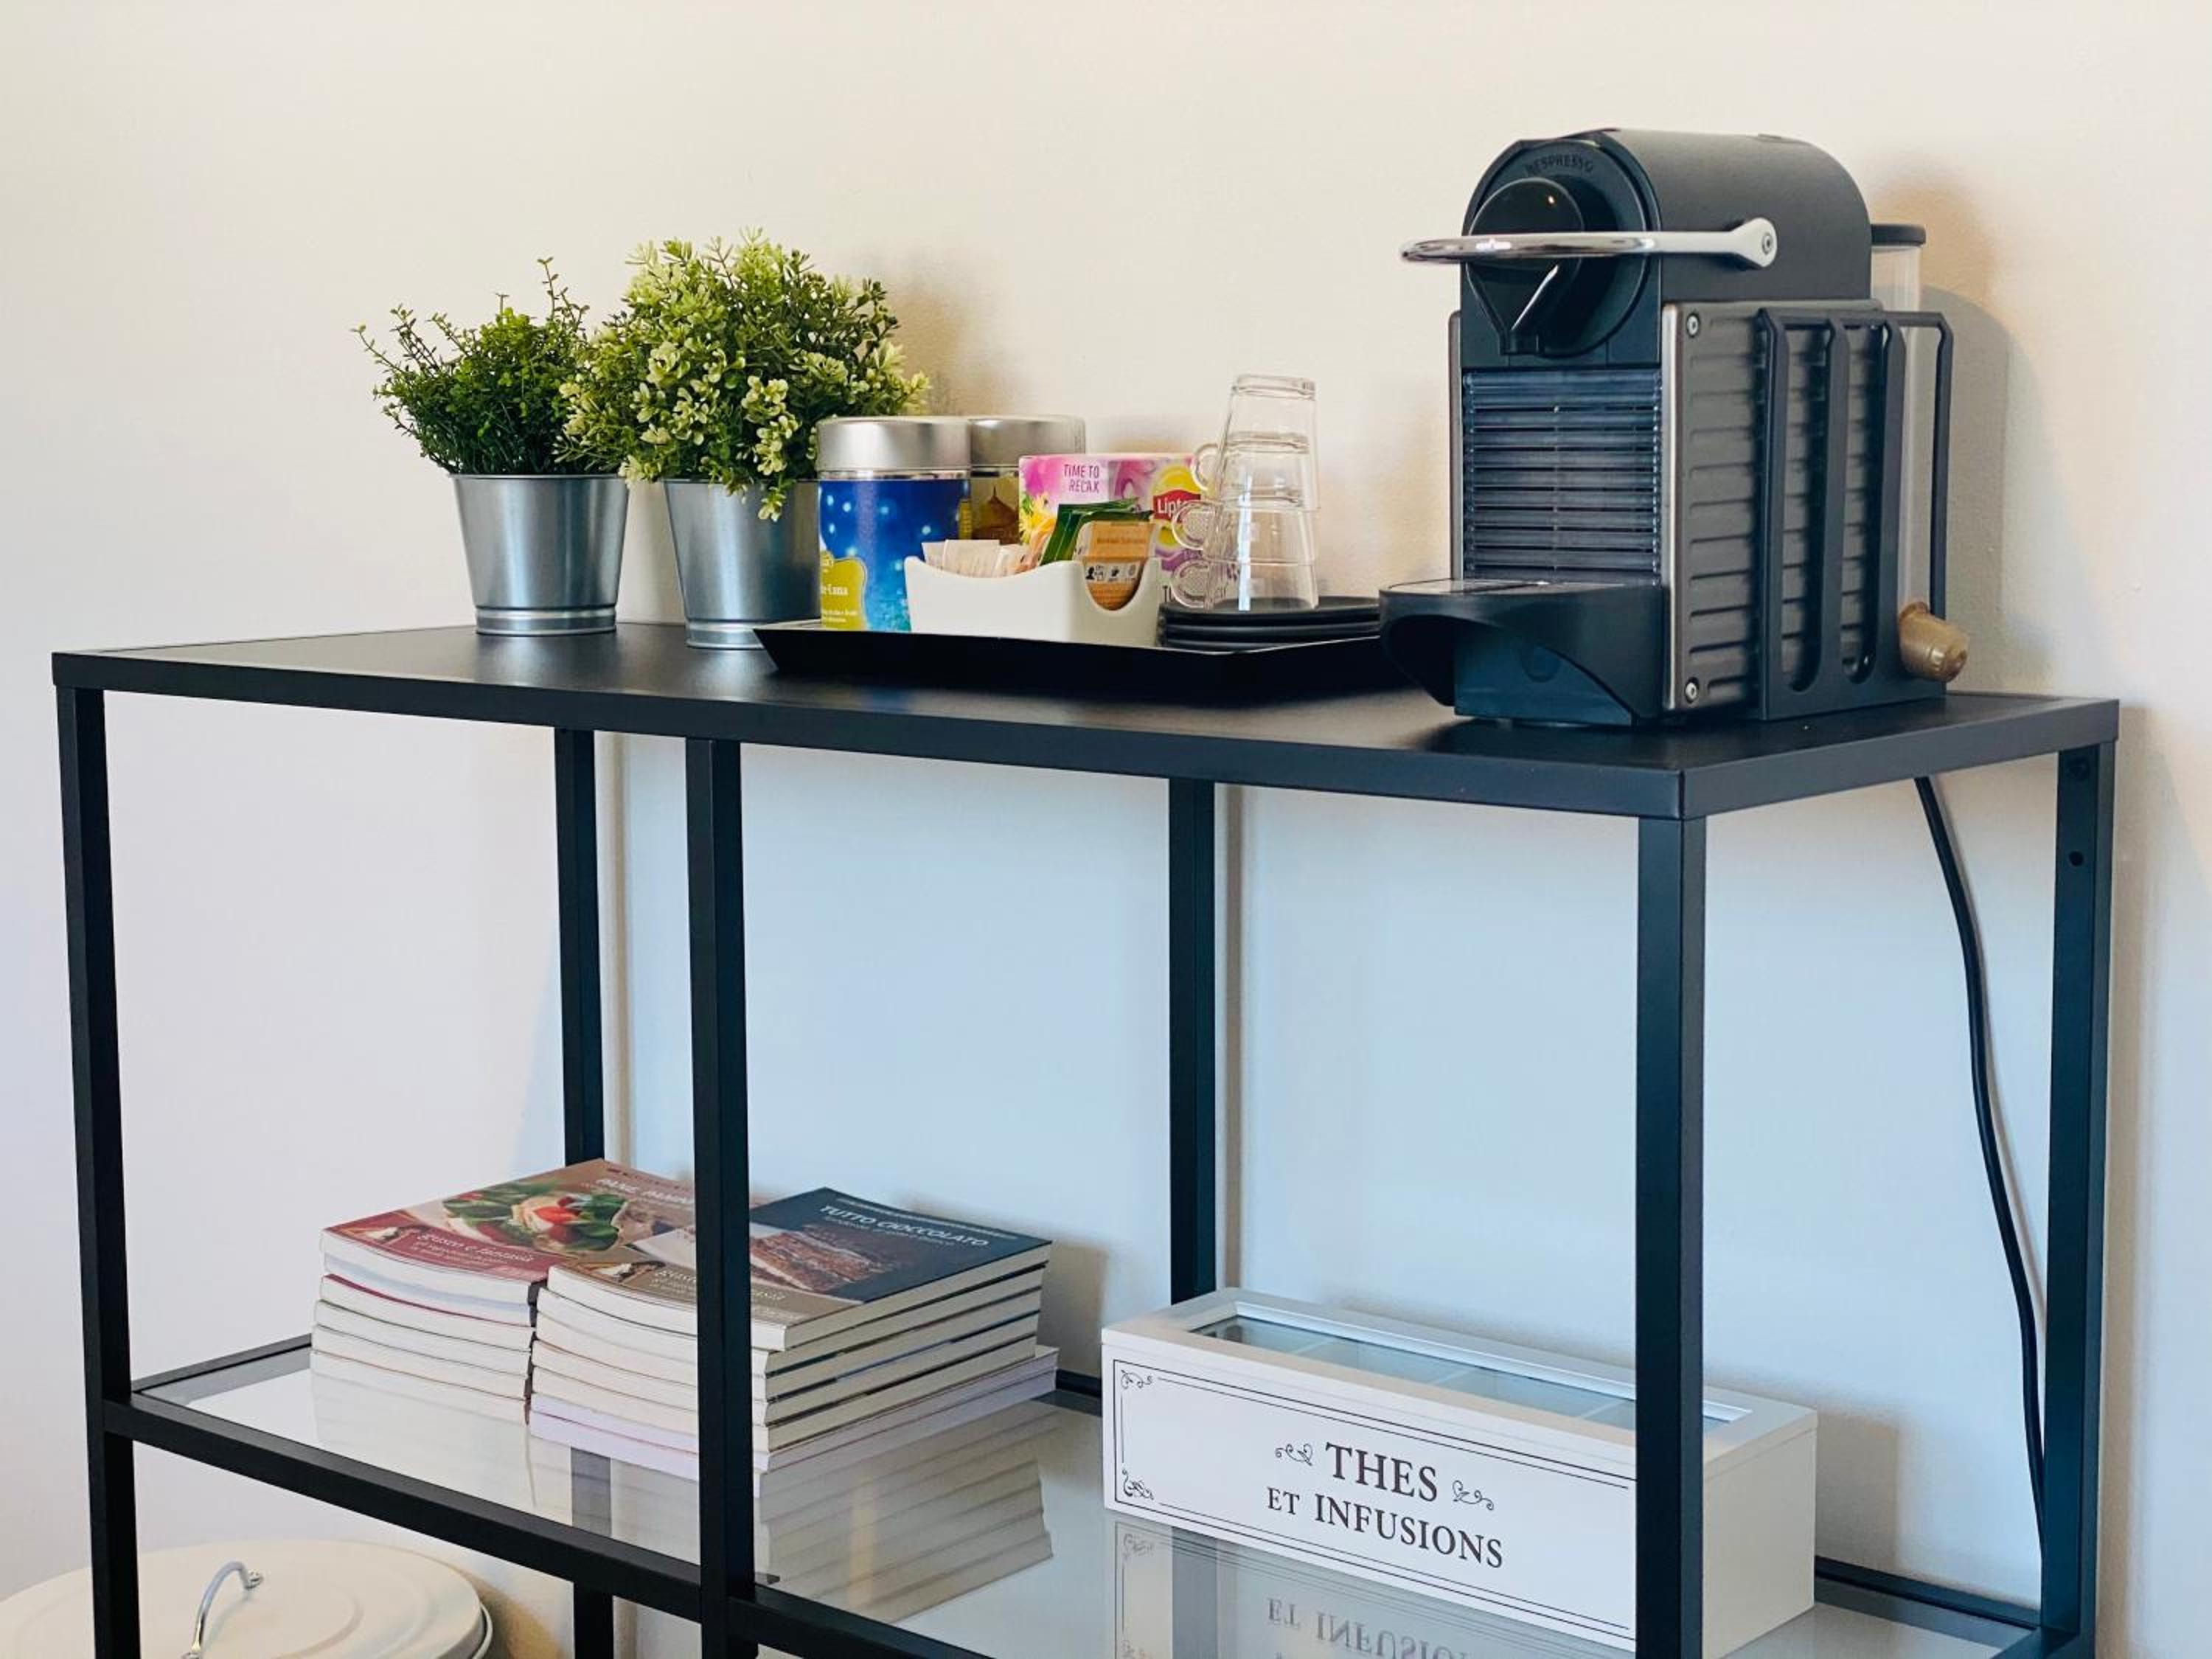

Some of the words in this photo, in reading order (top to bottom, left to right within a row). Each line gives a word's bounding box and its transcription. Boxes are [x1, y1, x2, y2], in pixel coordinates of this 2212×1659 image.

[1064, 464, 1086, 479] TIME
[1088, 465, 1100, 479] TO
[1068, 479, 1100, 494] RELAX
[819, 1206, 877, 1224] TUTTO
[877, 1221, 990, 1247] CIOCCOLATO
[1325, 1441, 1439, 1503] THES
[1267, 1486, 1300, 1515] ET
[1315, 1492, 1503, 1569] INFUSIONS
